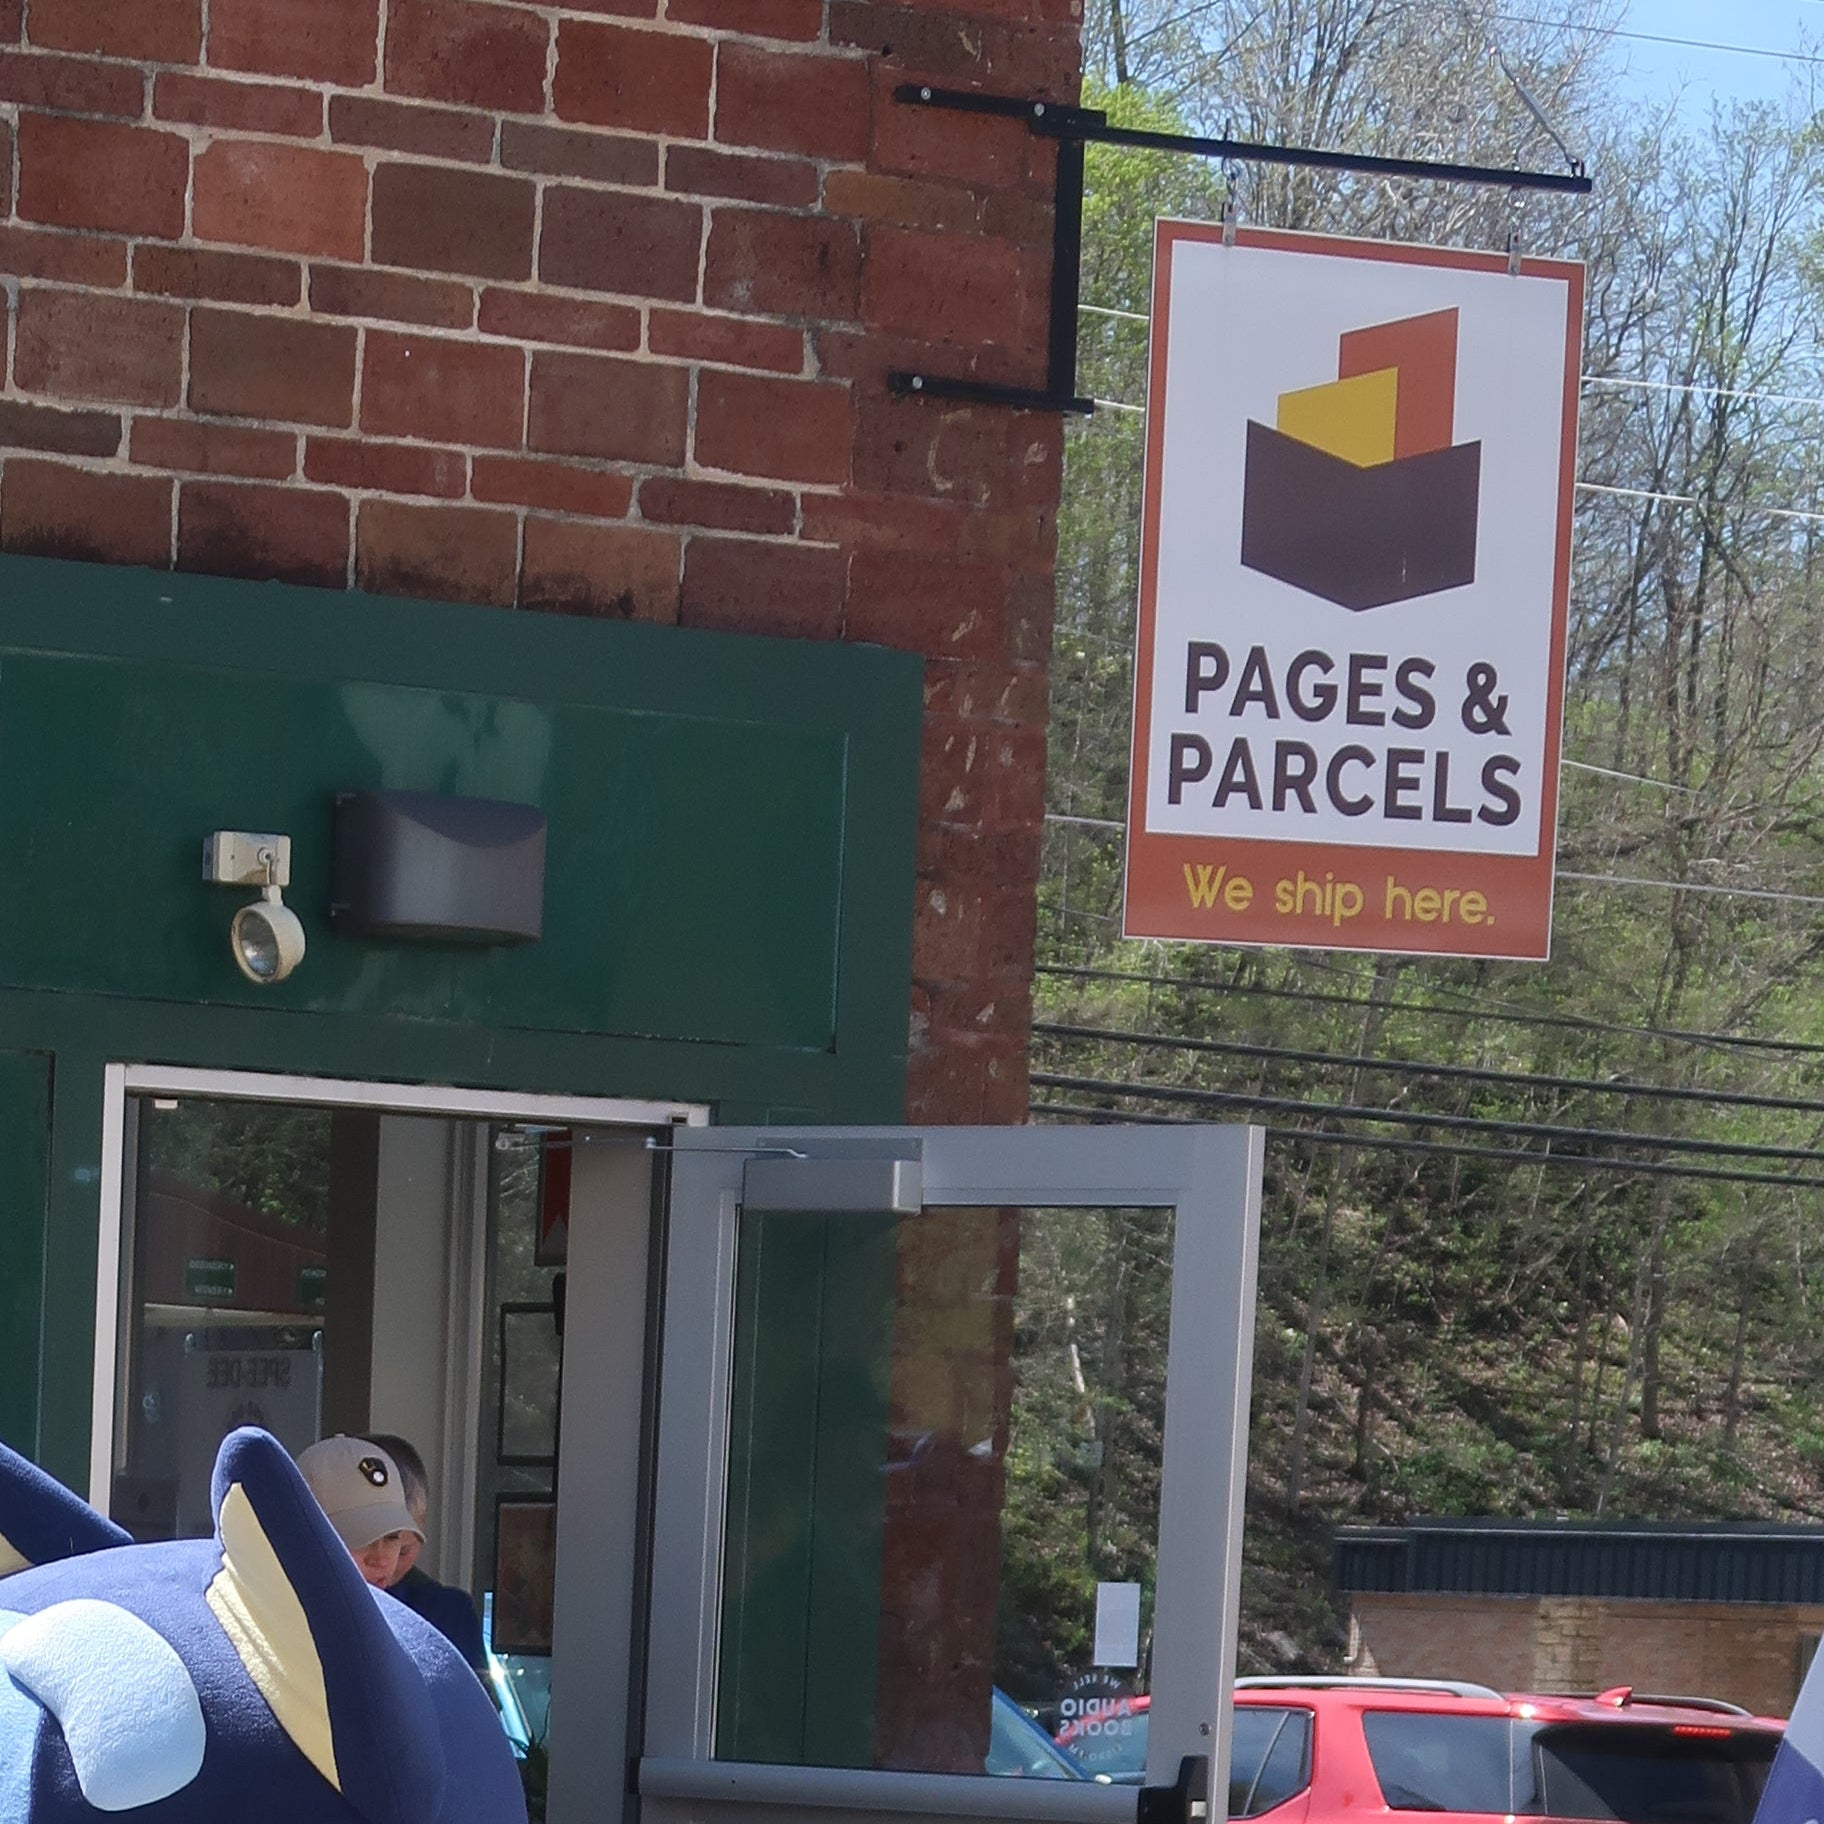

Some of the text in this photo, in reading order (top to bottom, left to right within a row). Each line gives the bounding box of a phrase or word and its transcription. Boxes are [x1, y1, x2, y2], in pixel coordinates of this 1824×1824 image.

[1185, 640, 1512, 736] PAGES &
[1167, 732, 1522, 826] PARCELS
[1182, 862, 1495, 927] We ship here.
